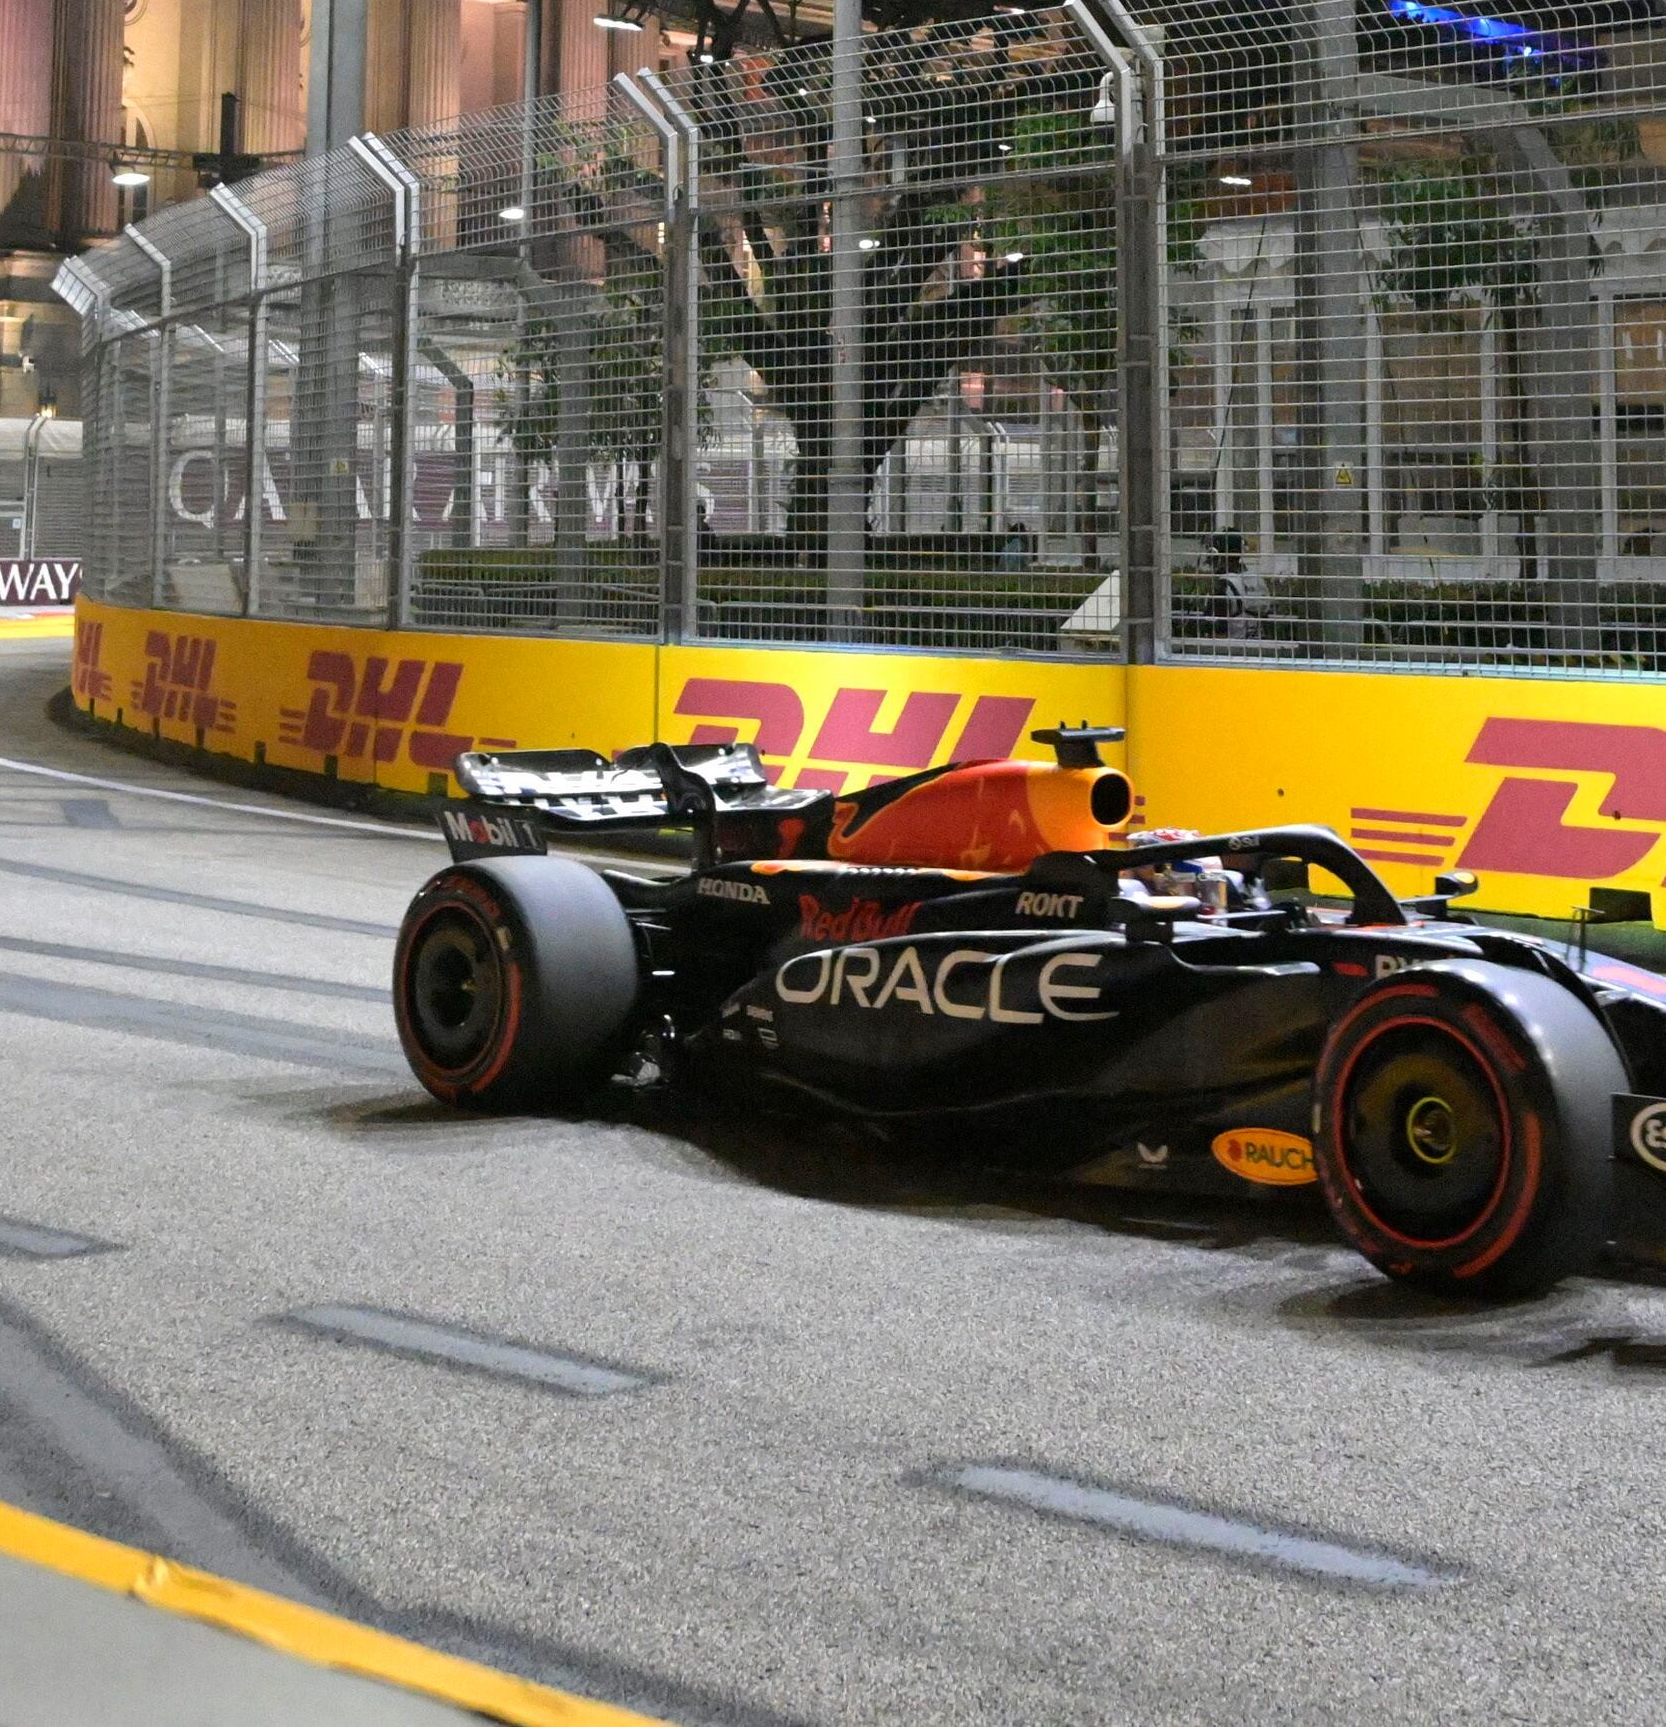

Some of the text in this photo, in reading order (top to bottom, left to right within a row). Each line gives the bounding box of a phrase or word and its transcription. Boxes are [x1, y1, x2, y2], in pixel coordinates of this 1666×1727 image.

[142, 631, 219, 729] DHL
[304, 649, 475, 770] DHL
[444, 811, 519, 848] Mobil
[696, 877, 771, 905] HONDA
[1014, 891, 1084, 919] ROKT
[775, 945, 1120, 1024] ORACLE
